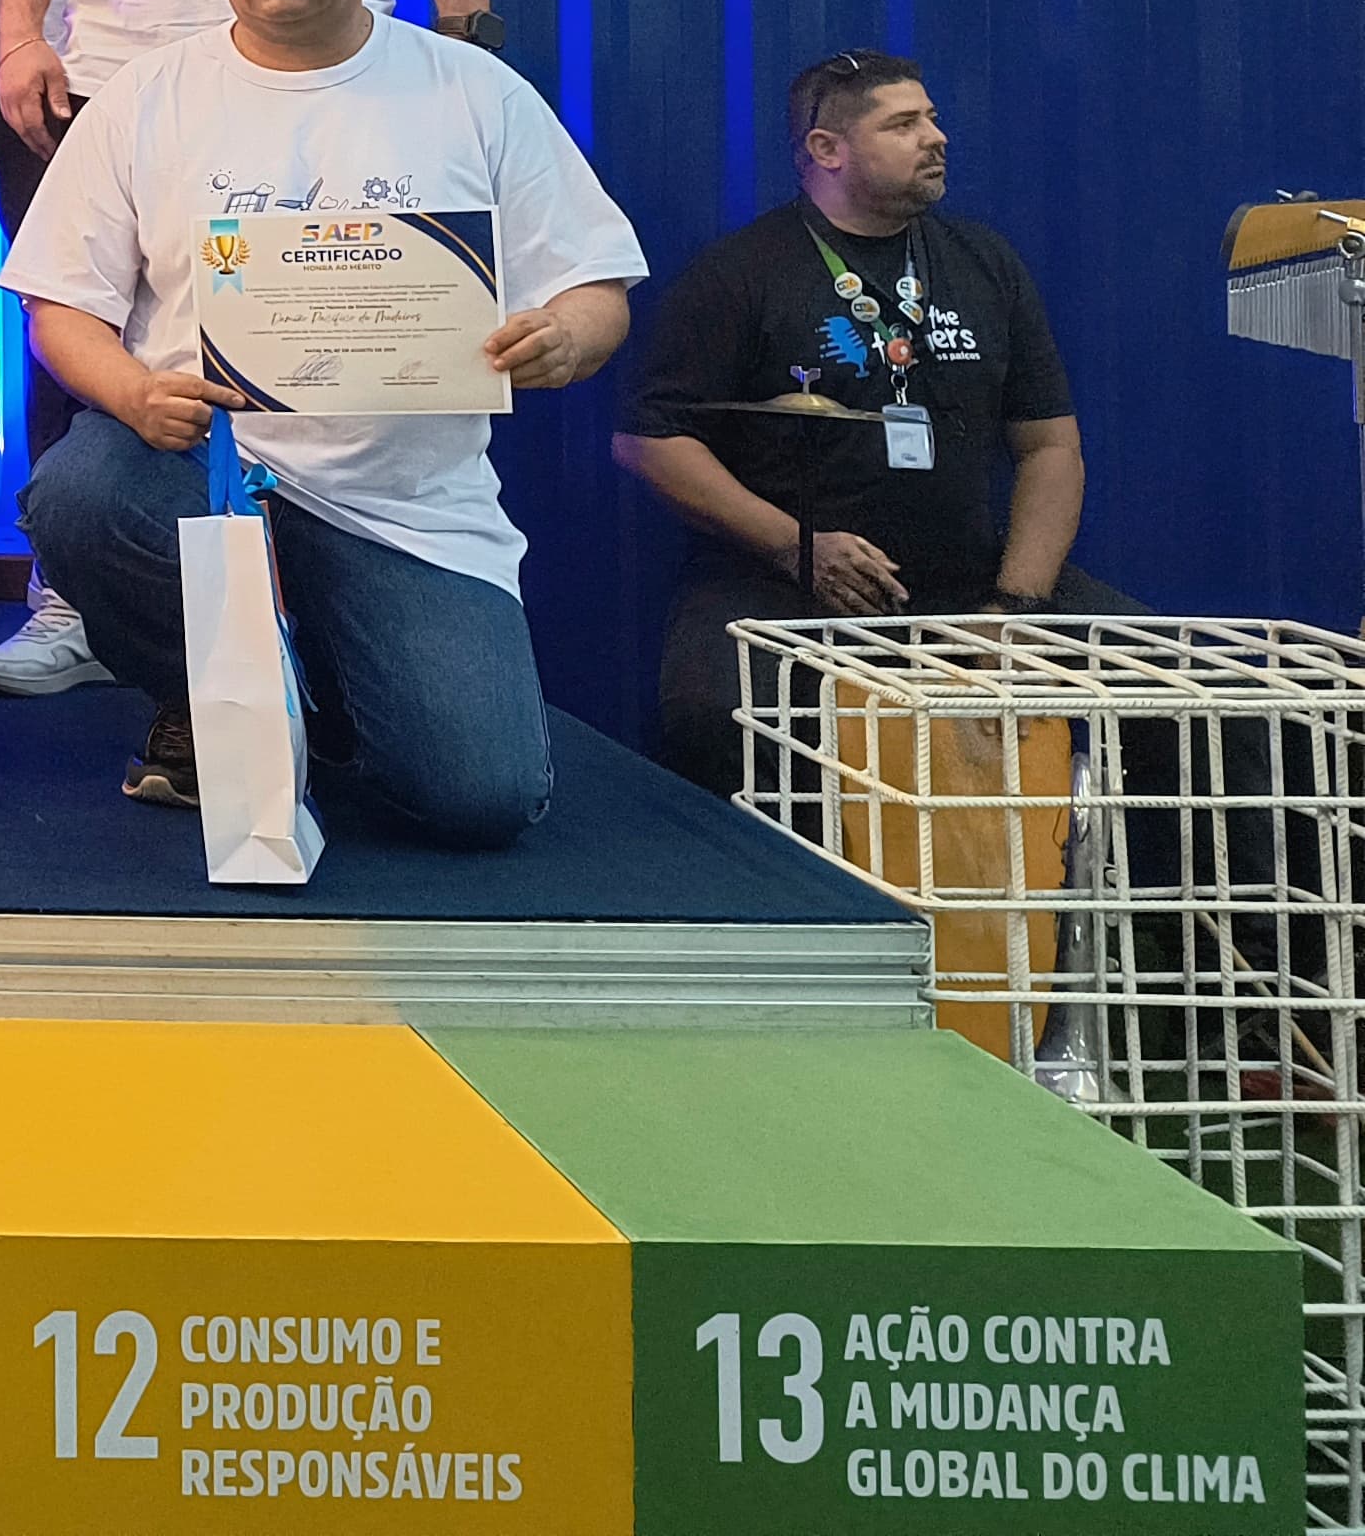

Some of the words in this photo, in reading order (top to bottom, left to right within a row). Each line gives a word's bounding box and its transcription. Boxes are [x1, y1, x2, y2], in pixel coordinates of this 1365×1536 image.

[281, 248, 402, 263] CERTIFICADO
[301, 222, 383, 243] SAEP
[303, 264, 333, 272] HONRA
[928, 305, 960, 330] the
[180, 1315, 402, 1365] CONSUMO
[417, 1319, 441, 1365] E
[844, 1307, 969, 1371] AÇÃO
[983, 1316, 1171, 1367] CONTRA
[33, 1310, 159, 1459] 12
[181, 1375, 432, 1441] PRODUÇÃO
[695, 1313, 825, 1464] 13
[845, 1382, 877, 1429] A
[891, 1384, 1124, 1443] MUDANÇA
[181, 1443, 523, 1501] RESPONSÁVEIS
[847, 1449, 1030, 1499] GLOBAL
[1043, 1453, 1108, 1501] DO
[1122, 1454, 1265, 1505] CLIMA
